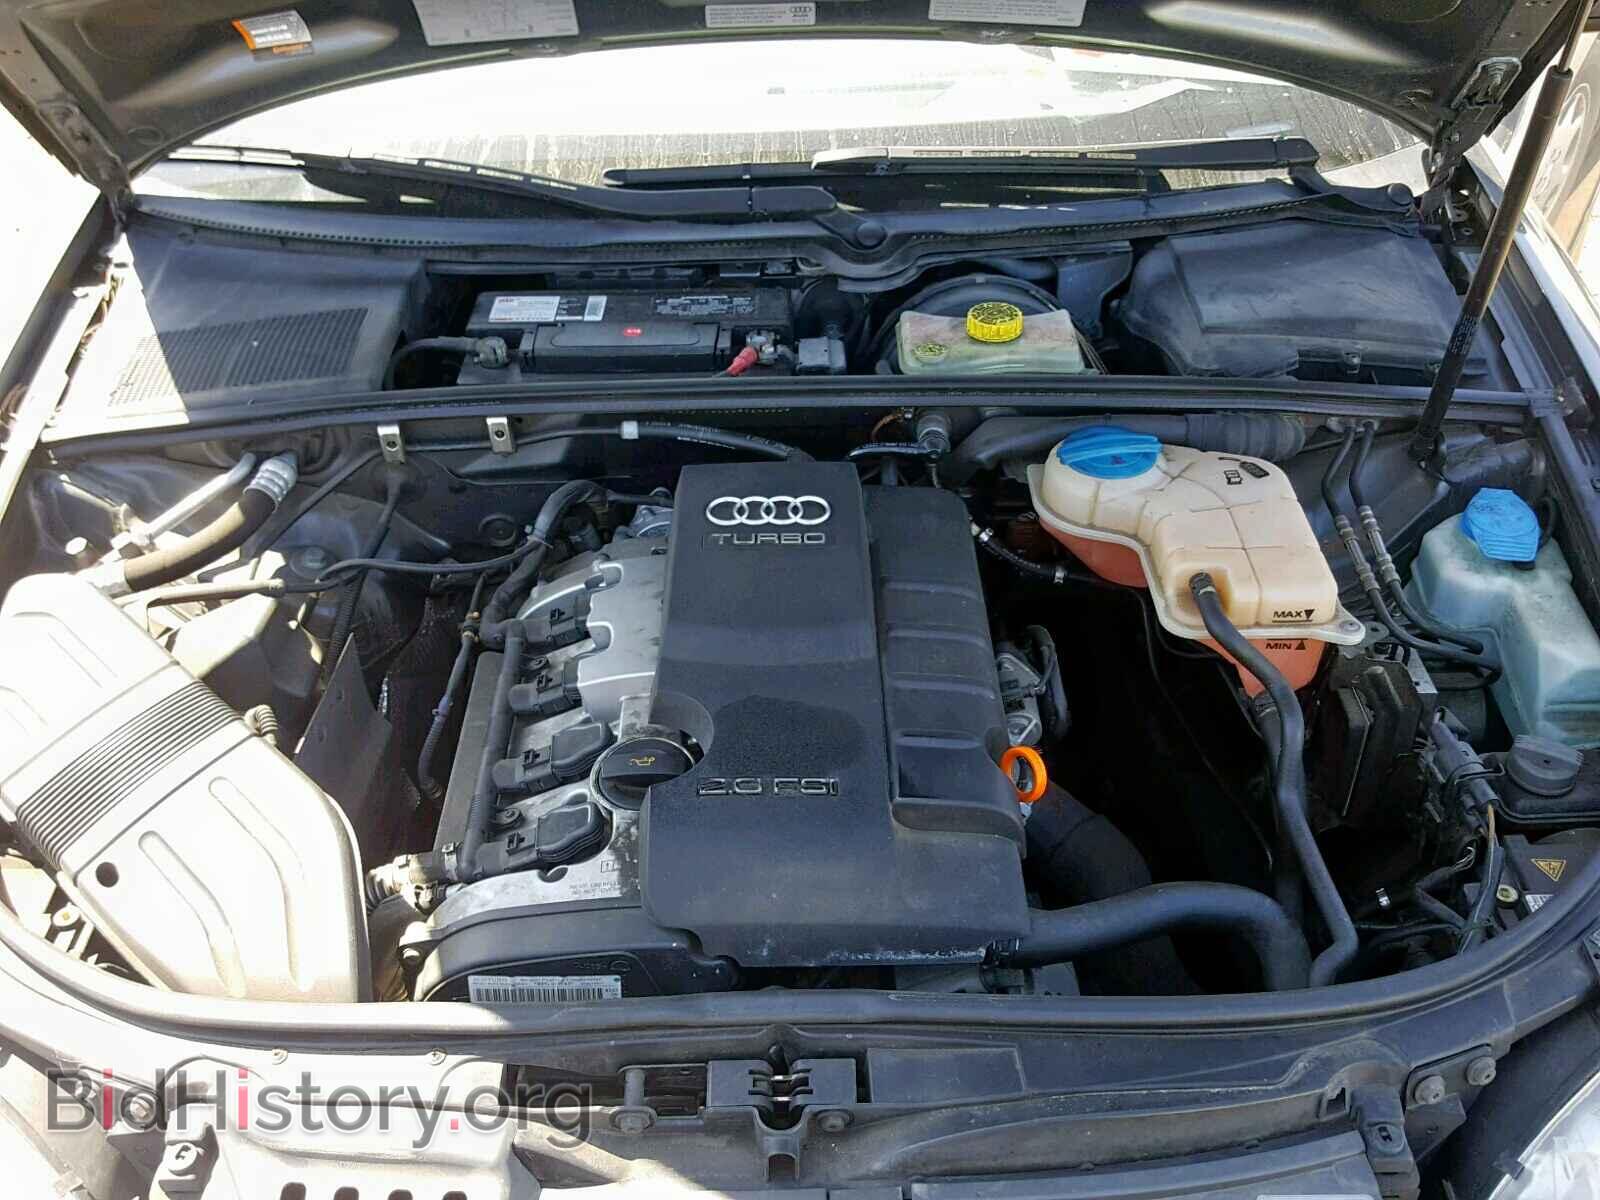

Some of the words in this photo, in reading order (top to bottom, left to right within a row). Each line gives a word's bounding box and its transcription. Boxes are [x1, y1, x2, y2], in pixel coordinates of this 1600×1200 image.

[711, 532, 825, 545] TURBO
[1272, 610, 1304, 619] MAX
[1265, 642, 1293, 650] MIN
[698, 777, 762, 796] 2.0
[774, 777, 840, 796] FSI
